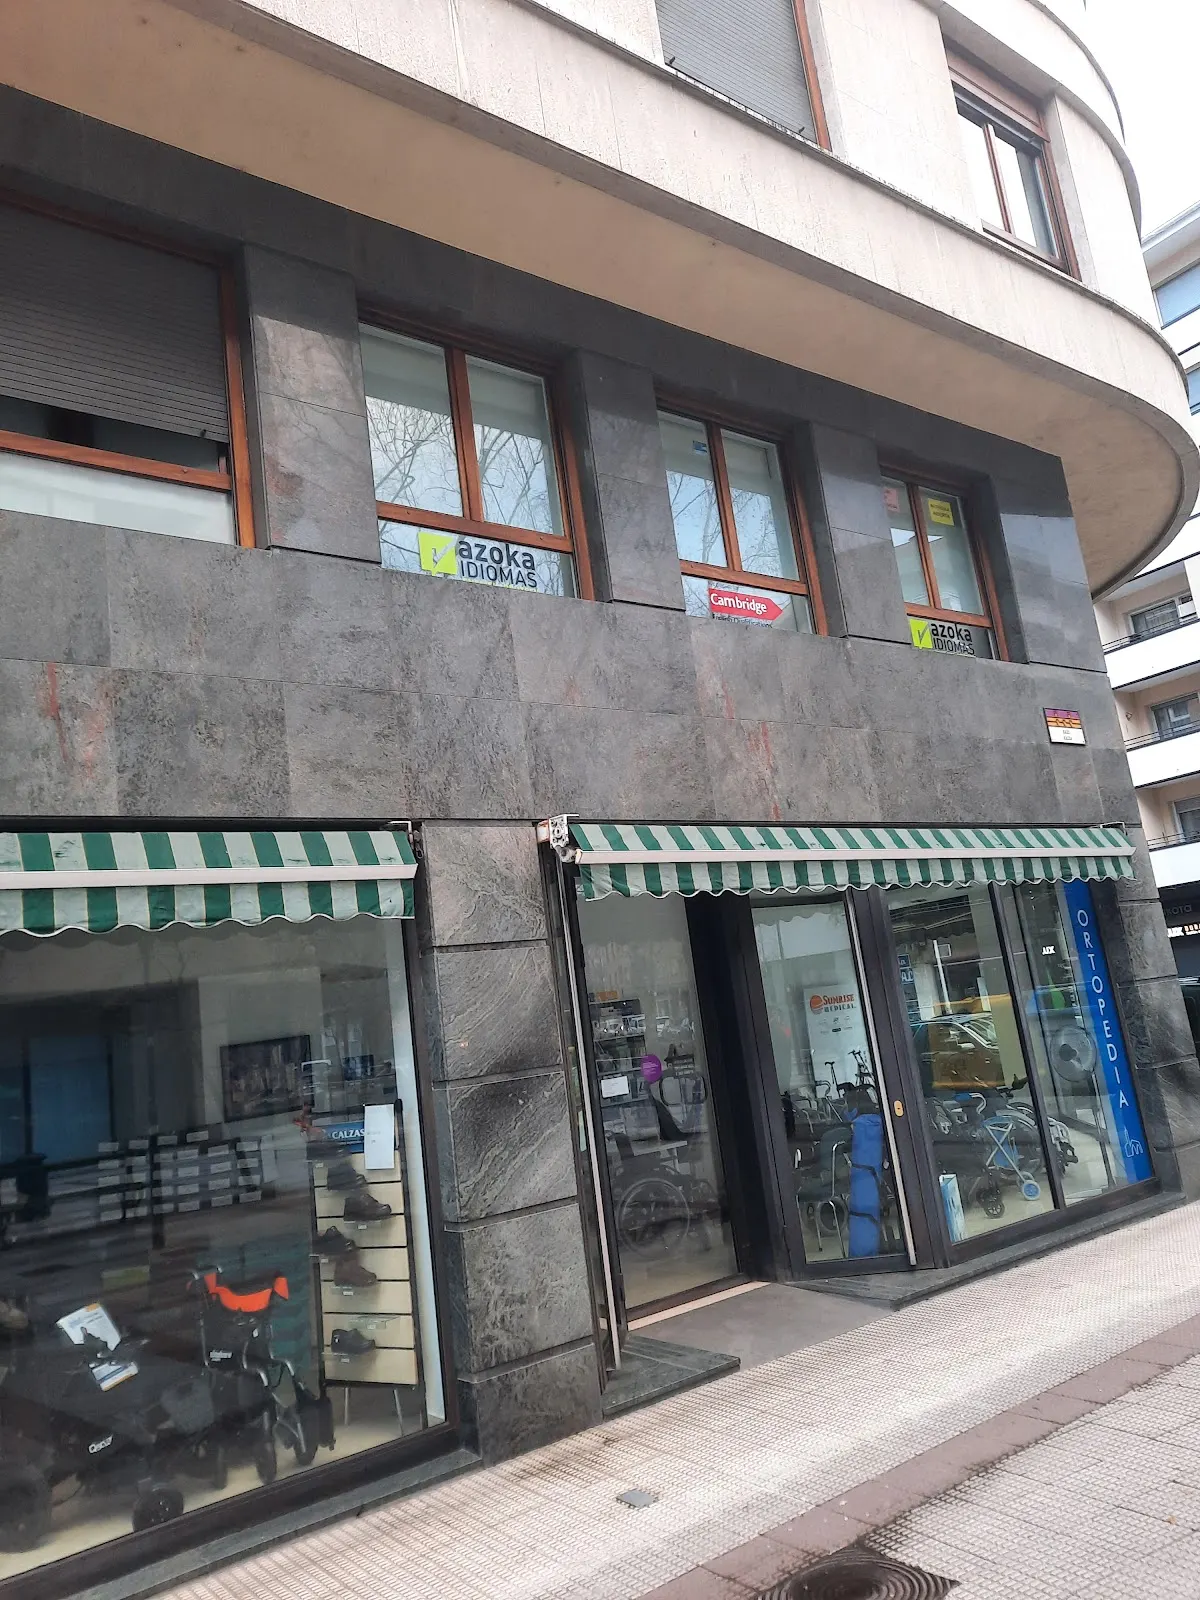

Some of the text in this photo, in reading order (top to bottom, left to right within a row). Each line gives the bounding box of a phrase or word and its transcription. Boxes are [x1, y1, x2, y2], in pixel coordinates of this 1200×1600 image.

[458, 540, 536, 570] azoka
[460, 560, 538, 588] IDIOMAS
[710, 593, 767, 615] Cambridge
[930, 623, 973, 642] azoka
[933, 638, 975, 655] IDIOMAS
[822, 994, 854, 1005] SUNRISE
[1076, 909, 1129, 1108] ORTOPEDIA
